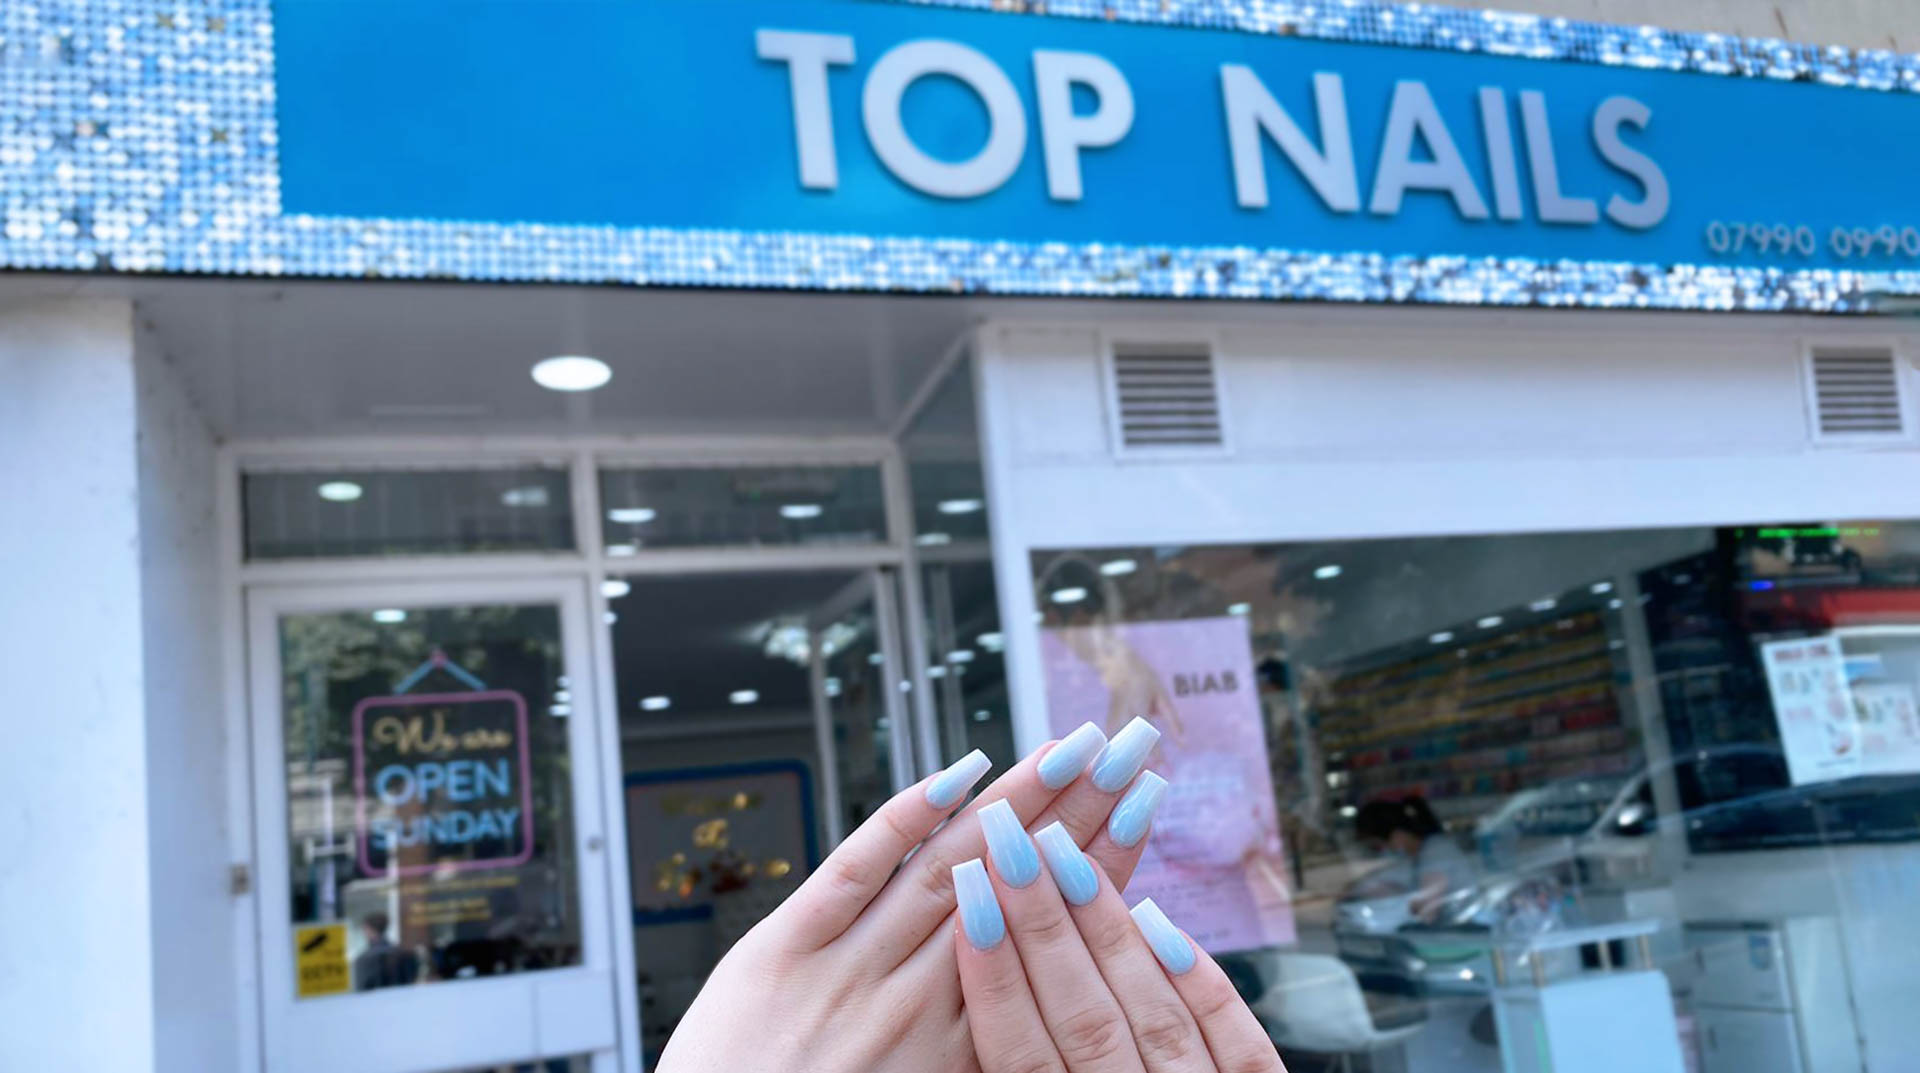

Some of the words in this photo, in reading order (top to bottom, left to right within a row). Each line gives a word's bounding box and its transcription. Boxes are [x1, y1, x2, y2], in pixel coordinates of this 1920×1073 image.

[755, 28, 1136, 200] TOP
[1220, 62, 1672, 230] NAILS
[1706, 219, 1816, 256] 07990
[1173, 670, 1240, 698] BIAB
[374, 757, 510, 807] OPEN
[370, 806, 521, 849] SUNDAY
